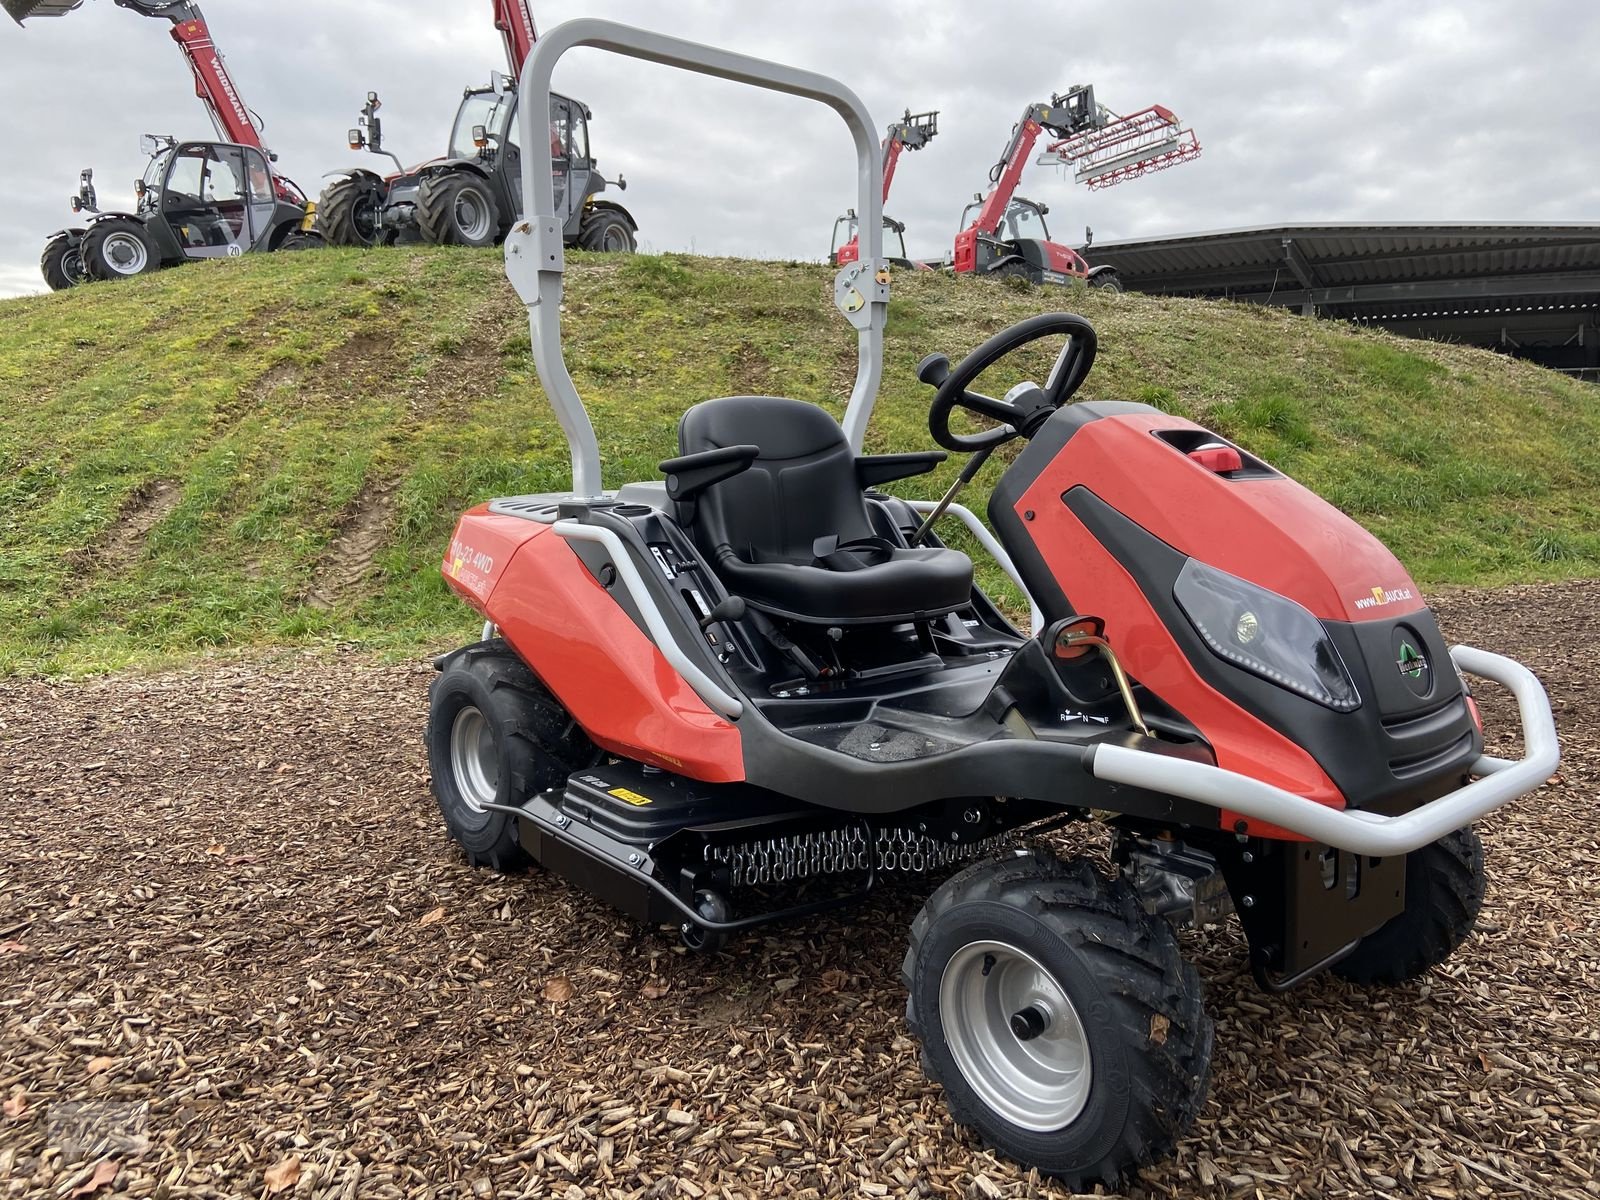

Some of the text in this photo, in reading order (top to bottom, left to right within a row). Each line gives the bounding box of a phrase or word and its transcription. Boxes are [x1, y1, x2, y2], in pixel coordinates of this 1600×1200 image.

[210, 56, 249, 126] WEIDEMANN
[230, 246, 240, 257] 20
[473, 551, 494, 575] 4WD
[1060, 713, 1066, 721] R
[1082, 715, 1089, 723] N
